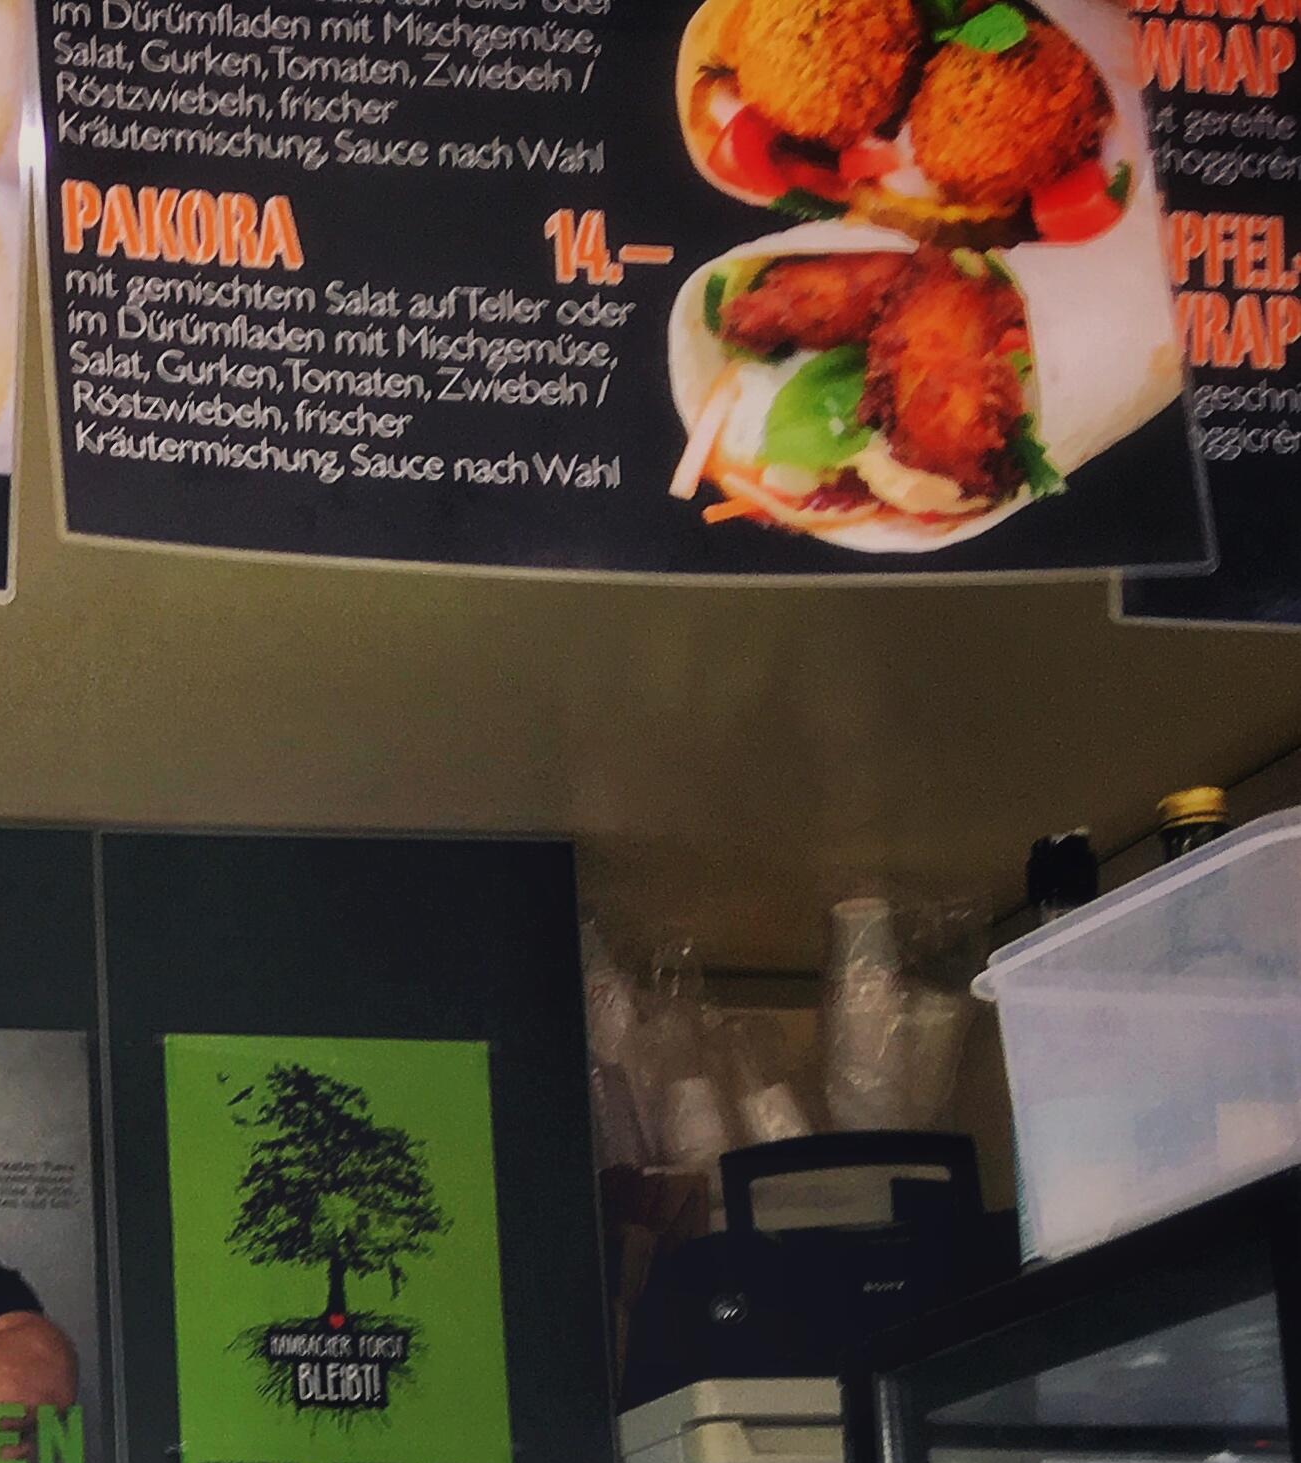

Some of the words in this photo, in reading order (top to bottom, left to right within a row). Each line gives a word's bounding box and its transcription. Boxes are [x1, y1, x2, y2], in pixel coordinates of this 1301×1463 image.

[102, 0, 311, 41] Dürümfladen
[320, 10, 375, 44] mit
[383, 10, 602, 58] Mischgemüse,
[1130, 17, 1296, 98] WRAP
[53, 31, 134, 74] Salat,
[141, 39, 269, 82] Gurken,
[267, 45, 417, 89] Tomaten,
[422, 50, 573, 93] Zwiebeln
[56, 70, 273, 121] Röstzwiebeln,
[280, 85, 398, 124] frischer
[334, 133, 429, 169] Sauce
[438, 138, 514, 170] nach
[516, 140, 605, 173] Wahl
[60, 177, 304, 271] PAKORA
[65, 266, 119, 299] mit
[126, 272, 317, 313] gemischtem
[325, 280, 401, 318] Salat
[408, 285, 460, 319] auf
[466, 286, 551, 324] Teller
[556, 297, 637, 329] oder
[67, 302, 108, 337] im
[117, 305, 325, 354] Dürümfladen
[334, 322, 390, 358] mit
[397, 325, 620, 370] Mischgemüse,
[69, 343, 152, 383] Salat,
[155, 348, 284, 395] Gurken,
[286, 356, 433, 403] Tomaten,
[436, 364, 589, 407] Zwiebeln
[72, 379, 291, 436] Röstzwiebeln,
[295, 398, 413, 440] frischer
[350, 442, 445, 481] Sauce
[453, 449, 529, 485] nach
[531, 452, 621, 490] Wahl
[298, 1361, 381, 1401] BLEIBT!
